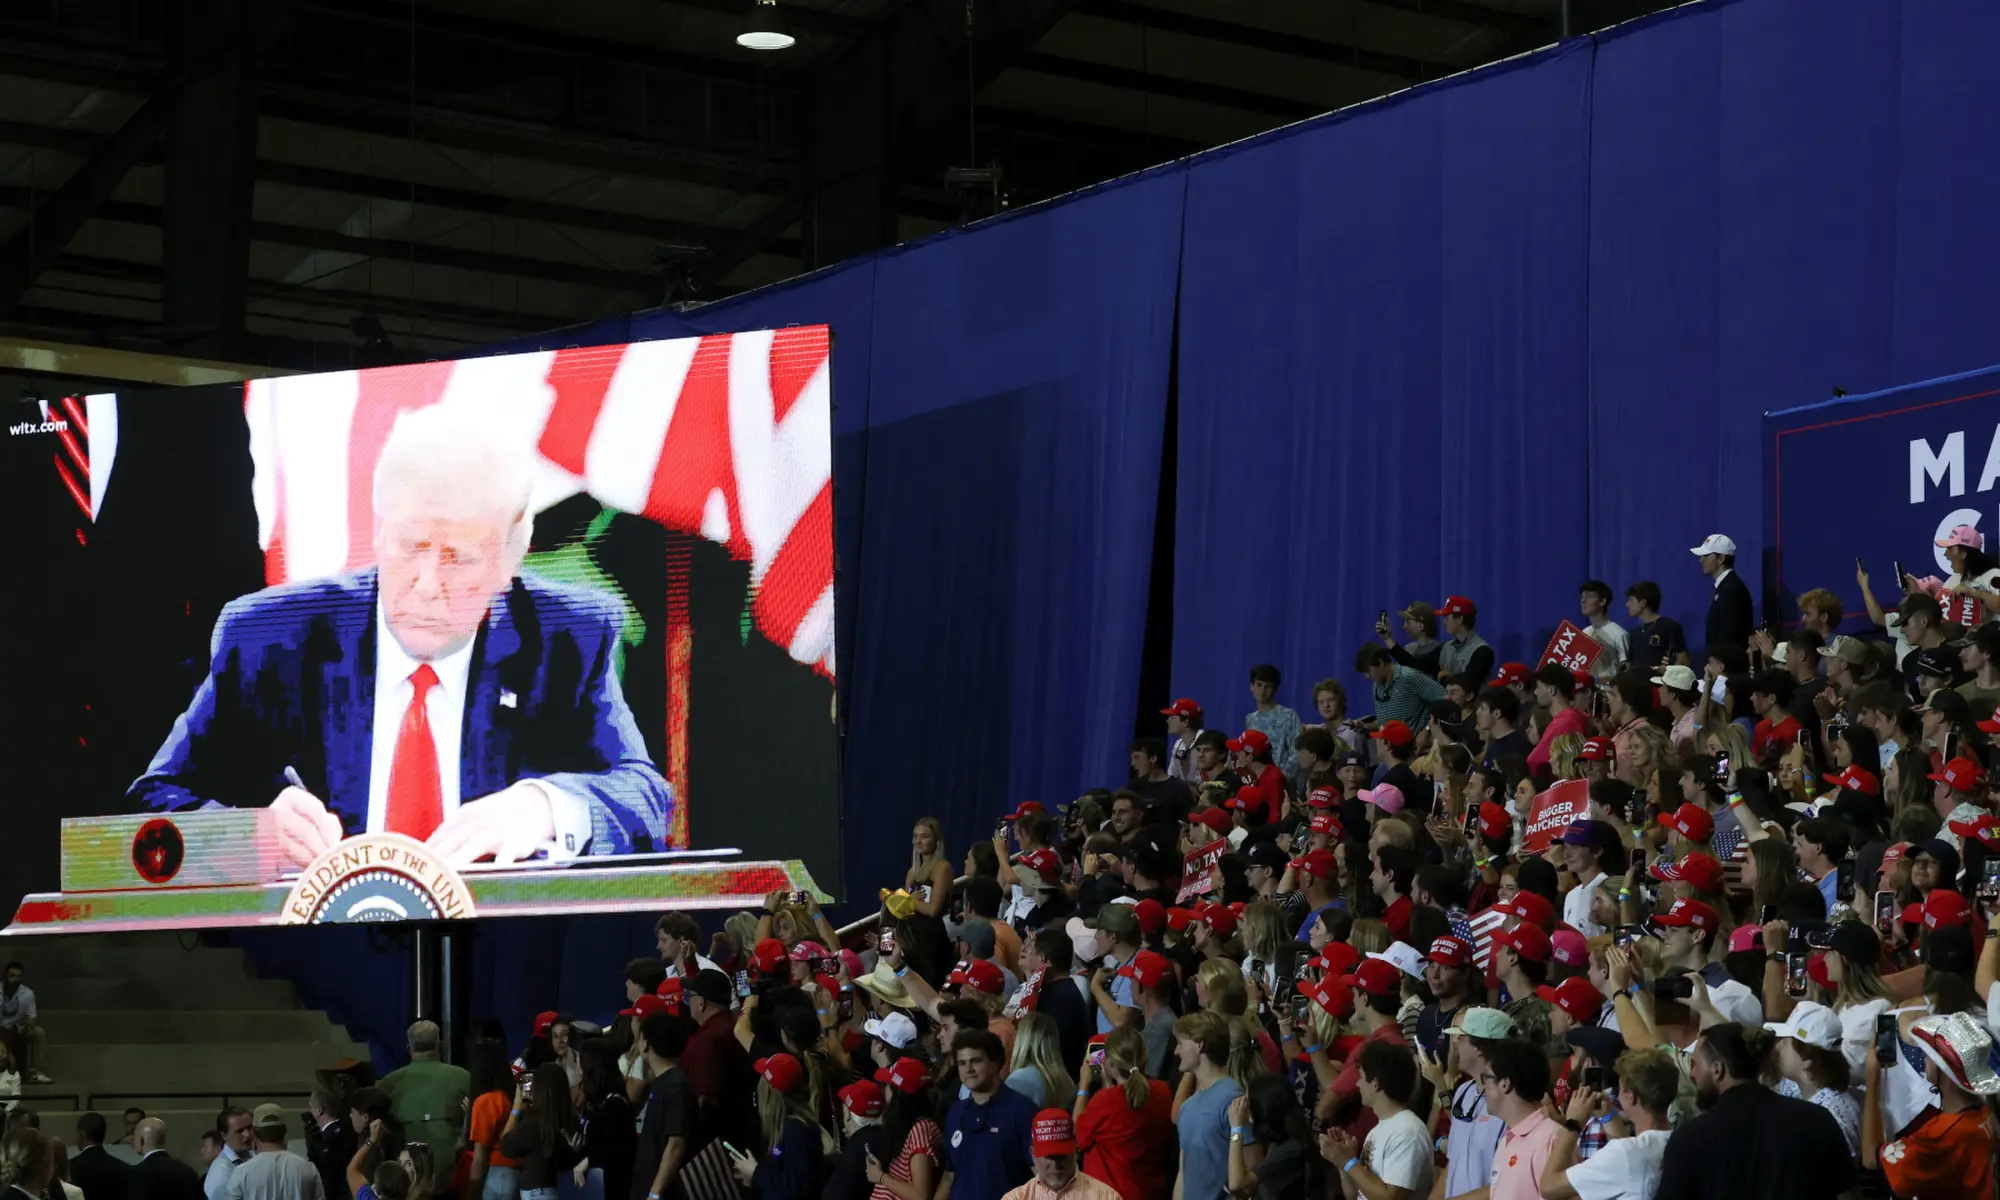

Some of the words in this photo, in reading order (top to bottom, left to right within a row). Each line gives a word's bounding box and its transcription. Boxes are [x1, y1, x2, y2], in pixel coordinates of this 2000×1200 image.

[9, 421, 67, 435] wltx.com
[1938, 594, 1951, 620] AX
[1553, 627, 1576, 656] TAX
[1561, 655, 1571, 668] ON
[1538, 801, 1572, 821] BIGGER
[1185, 857, 1200, 876] NO
[1202, 847, 1224, 868] TAX
[292, 844, 374, 922] ESIDENT
[379, 846, 400, 861] OF
[403, 851, 428, 874] THE
[1197, 869, 1208, 880] ON
